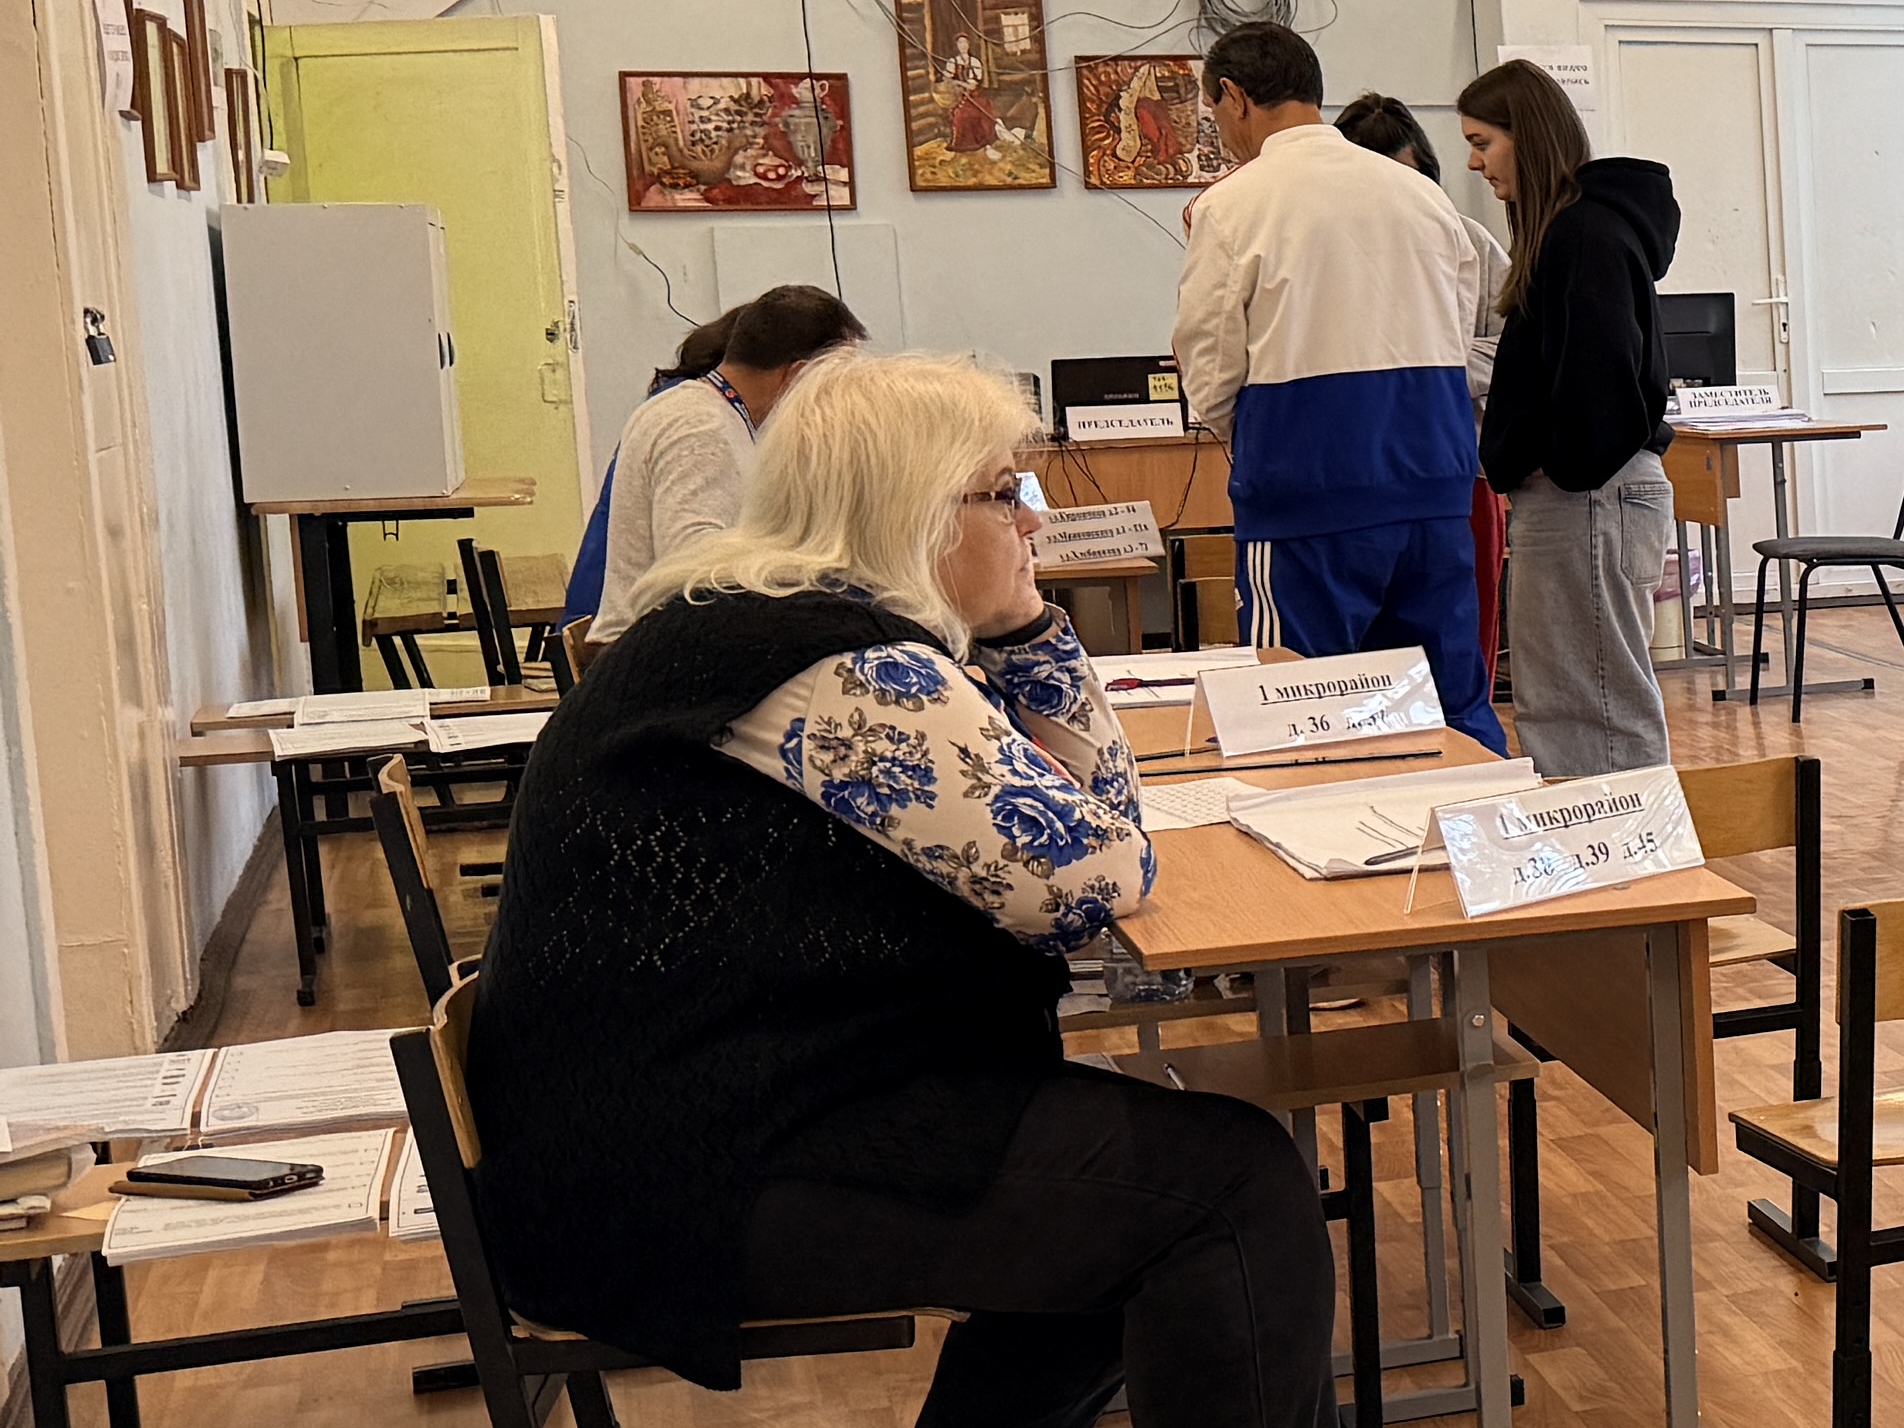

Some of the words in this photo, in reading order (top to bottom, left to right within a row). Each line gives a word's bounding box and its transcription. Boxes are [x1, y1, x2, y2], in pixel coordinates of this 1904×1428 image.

[1259, 684, 1268, 702] 1
[1274, 673, 1393, 700] микрорайон
[1308, 714, 1331, 734] 36
[1517, 791, 1643, 831] микрорайон
[1572, 841, 1611, 870] д.39
